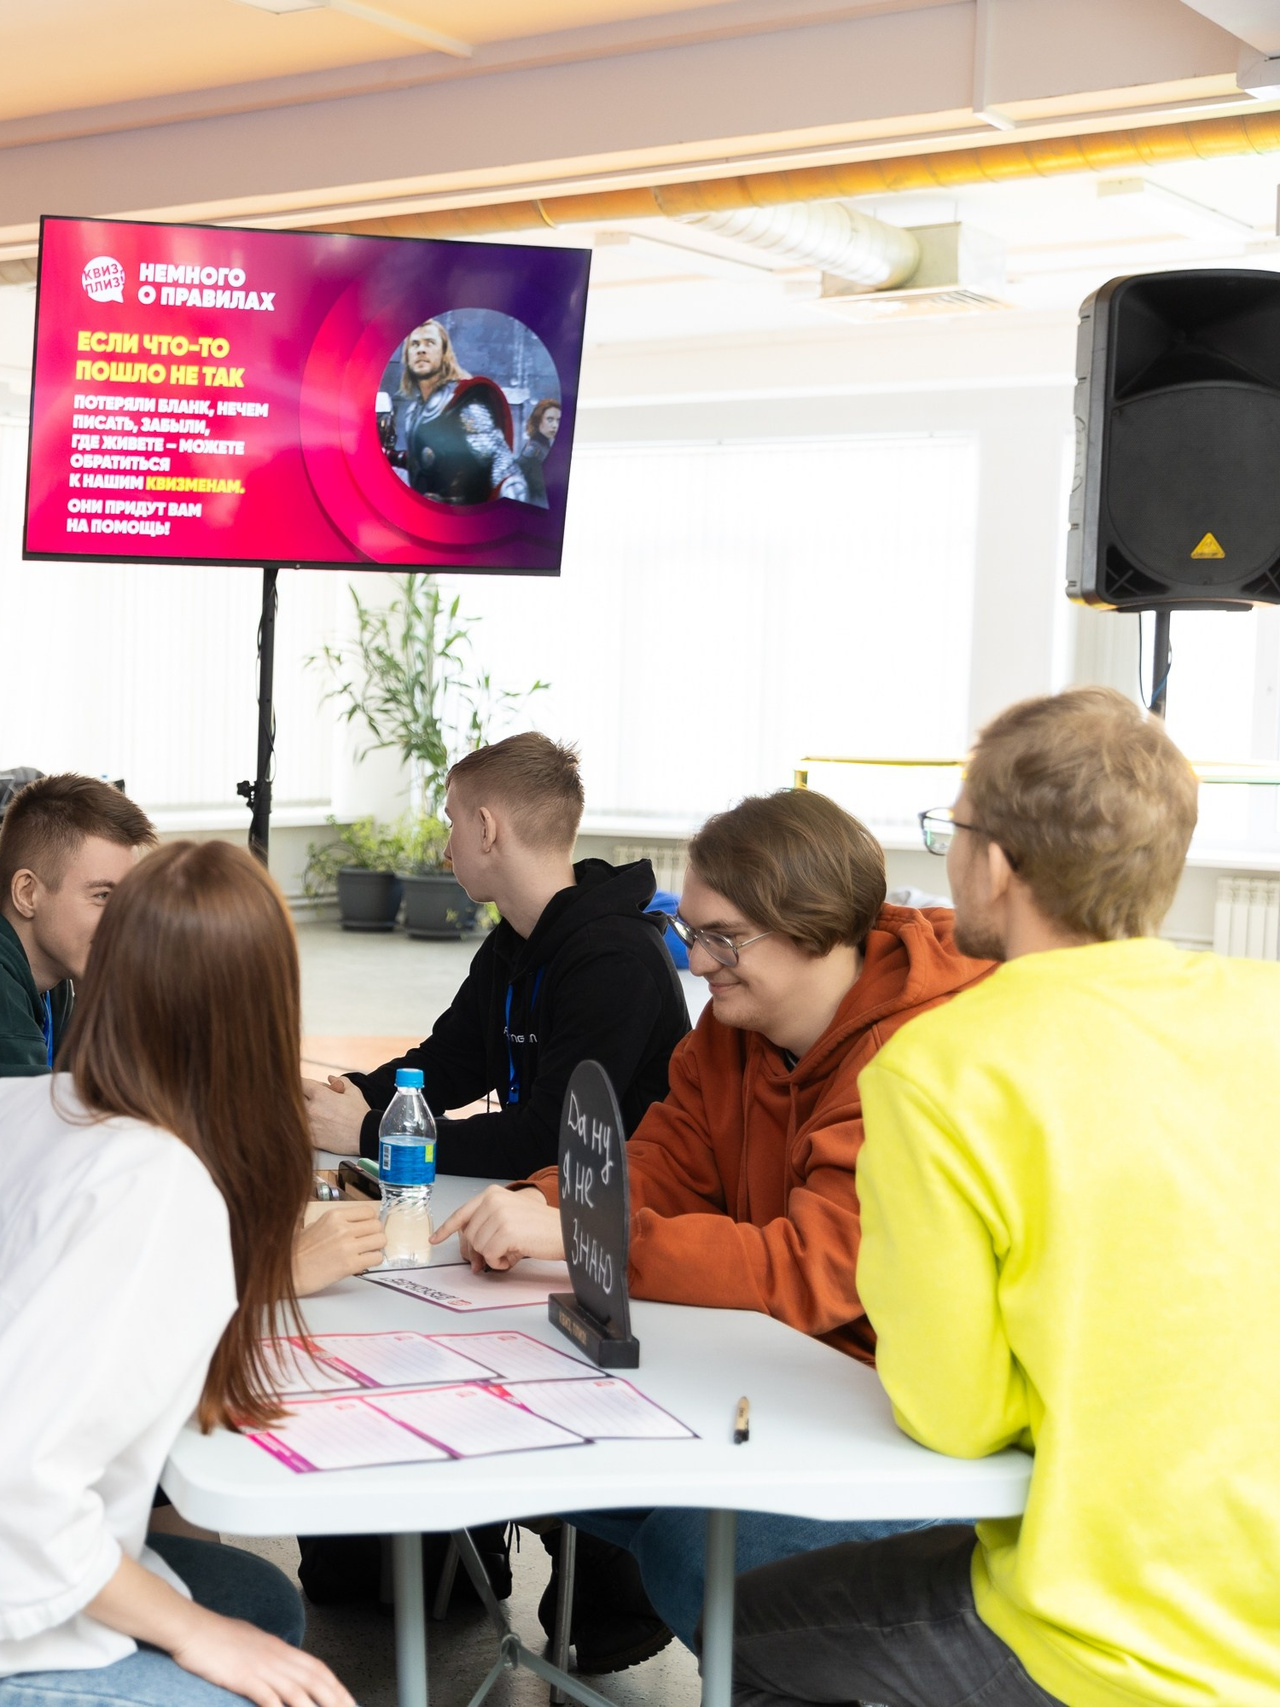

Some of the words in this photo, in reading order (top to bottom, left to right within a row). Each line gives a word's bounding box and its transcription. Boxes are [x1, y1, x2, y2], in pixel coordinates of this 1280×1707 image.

[84, 276, 125, 293] ПЛИЗ!
[139, 262, 246, 287] НЕМНОГО
[138, 285, 157, 305] О
[160, 286, 276, 311] ПРАВИЛАХ
[77, 330, 139, 354] ЕСЛИ
[142, 334, 230, 359] ЧТО-ТО
[75, 360, 167, 385] ПОШЛО
[170, 365, 199, 386] НЕ
[202, 366, 246, 388] ТАК
[73, 394, 156, 412] ПОТЕРЯЛИ
[157, 399, 215, 417] БЛАНК,
[217, 401, 269, 417] НЕЧЕМ
[72, 414, 139, 434] ПИСАТЬ,
[140, 417, 211, 436] ЗАБЫЛИ,
[71, 434, 100, 451] ГДЕ
[101, 435, 164, 452] ЖИВЕТЕ
[178, 438, 246, 456] МОЖЕТЕ
[70, 453, 171, 472] ОБРАТИТЬСЯ
[68, 473, 82, 488] К
[82, 474, 145, 490] НАШИМ
[145, 476, 246, 494] КВИЗМЕНАМ.
[67, 498, 103, 514] ОНИ
[104, 499, 167, 518] ПРИДУТ
[167, 502, 203, 518] ВАМ
[66, 518, 89, 533] НА
[90, 519, 171, 537] ПОМОЩЬ!
